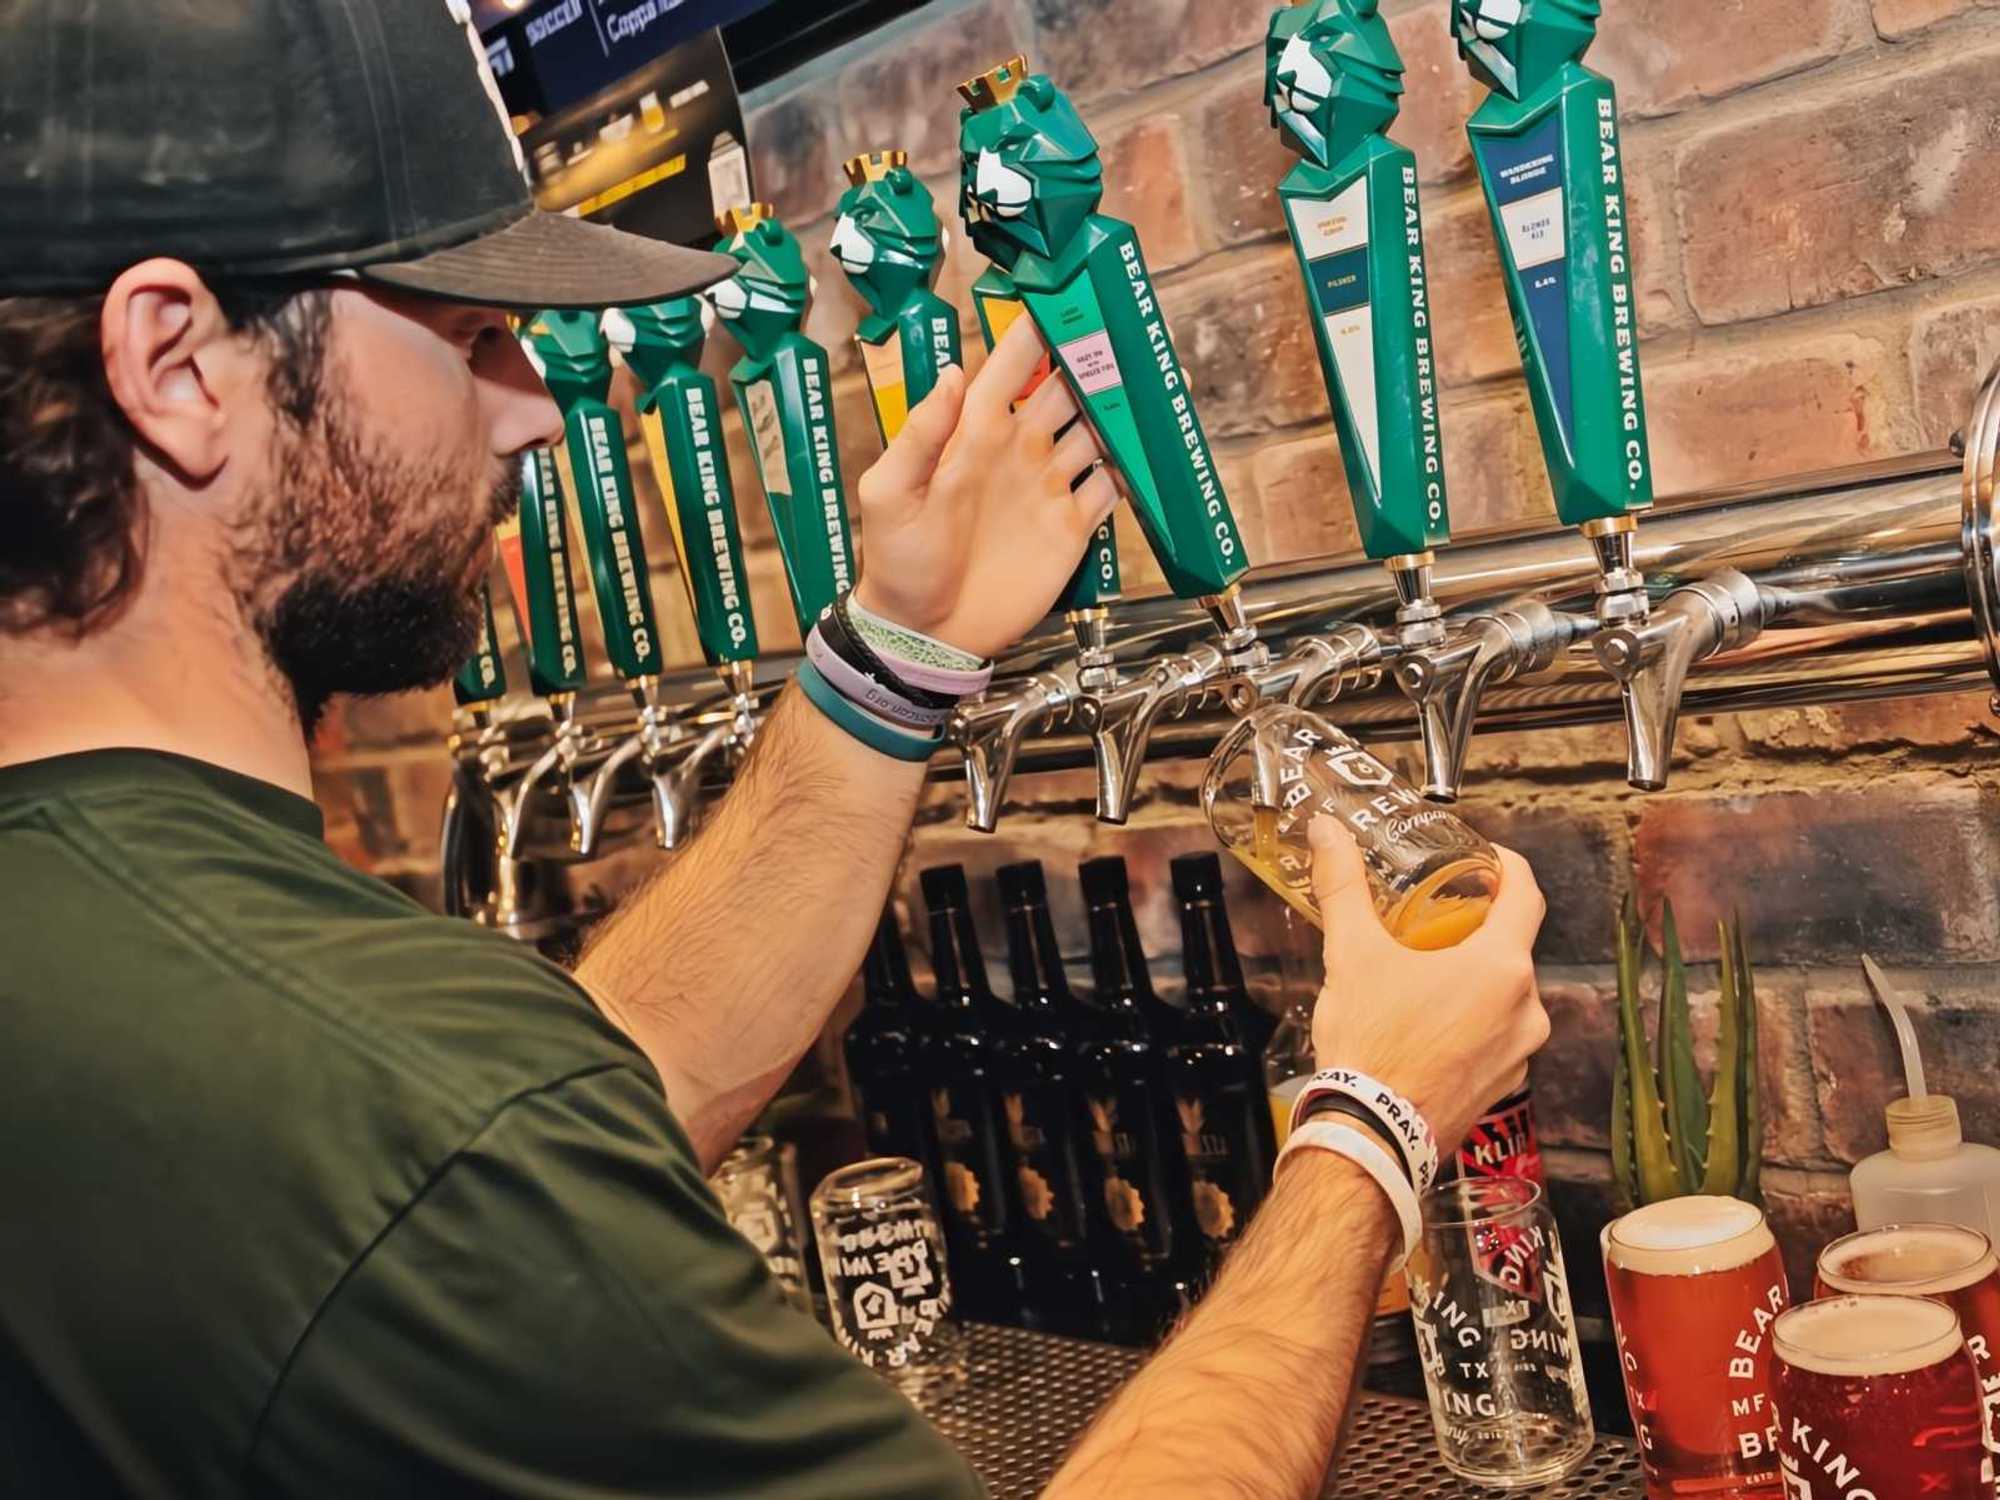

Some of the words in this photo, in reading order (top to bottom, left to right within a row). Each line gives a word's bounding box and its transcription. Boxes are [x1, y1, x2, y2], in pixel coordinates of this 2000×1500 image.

[1597, 99, 1617, 185] BEAR
[1402, 167, 1418, 246] BEAR
[1604, 194, 1625, 274] KING
[1407, 256, 1426, 329] KING
[931, 317, 954, 375] BEA
[1611, 284, 1638, 431] BREWING
[686, 388, 712, 449] BEAR
[803, 358, 824, 420] BEAR
[1119, 240, 1153, 316] BEAR
[1146, 320, 1178, 391] KING
[1171, 396, 1221, 518] BREWING
[1214, 521, 1234, 566] CO.
[1415, 338, 1438, 473] BREWING
[697, 450, 720, 506] KING
[813, 426, 834, 483] KING
[1625, 440, 1643, 490] CO.
[1427, 479, 1442, 529] CO.
[707, 510, 740, 610] BREWING
[822, 489, 852, 595] BREWING
[1099, 546, 1114, 589] CO.
[1279, 728, 1323, 809] BEAR
[1386, 809, 1452, 843] Compa
[1375, 1092, 1420, 1150] PRAY.
[1432, 1291, 1481, 1348] ING
[1728, 1284, 1784, 1380] BEAR
[1459, 1362, 1489, 1378] TX
